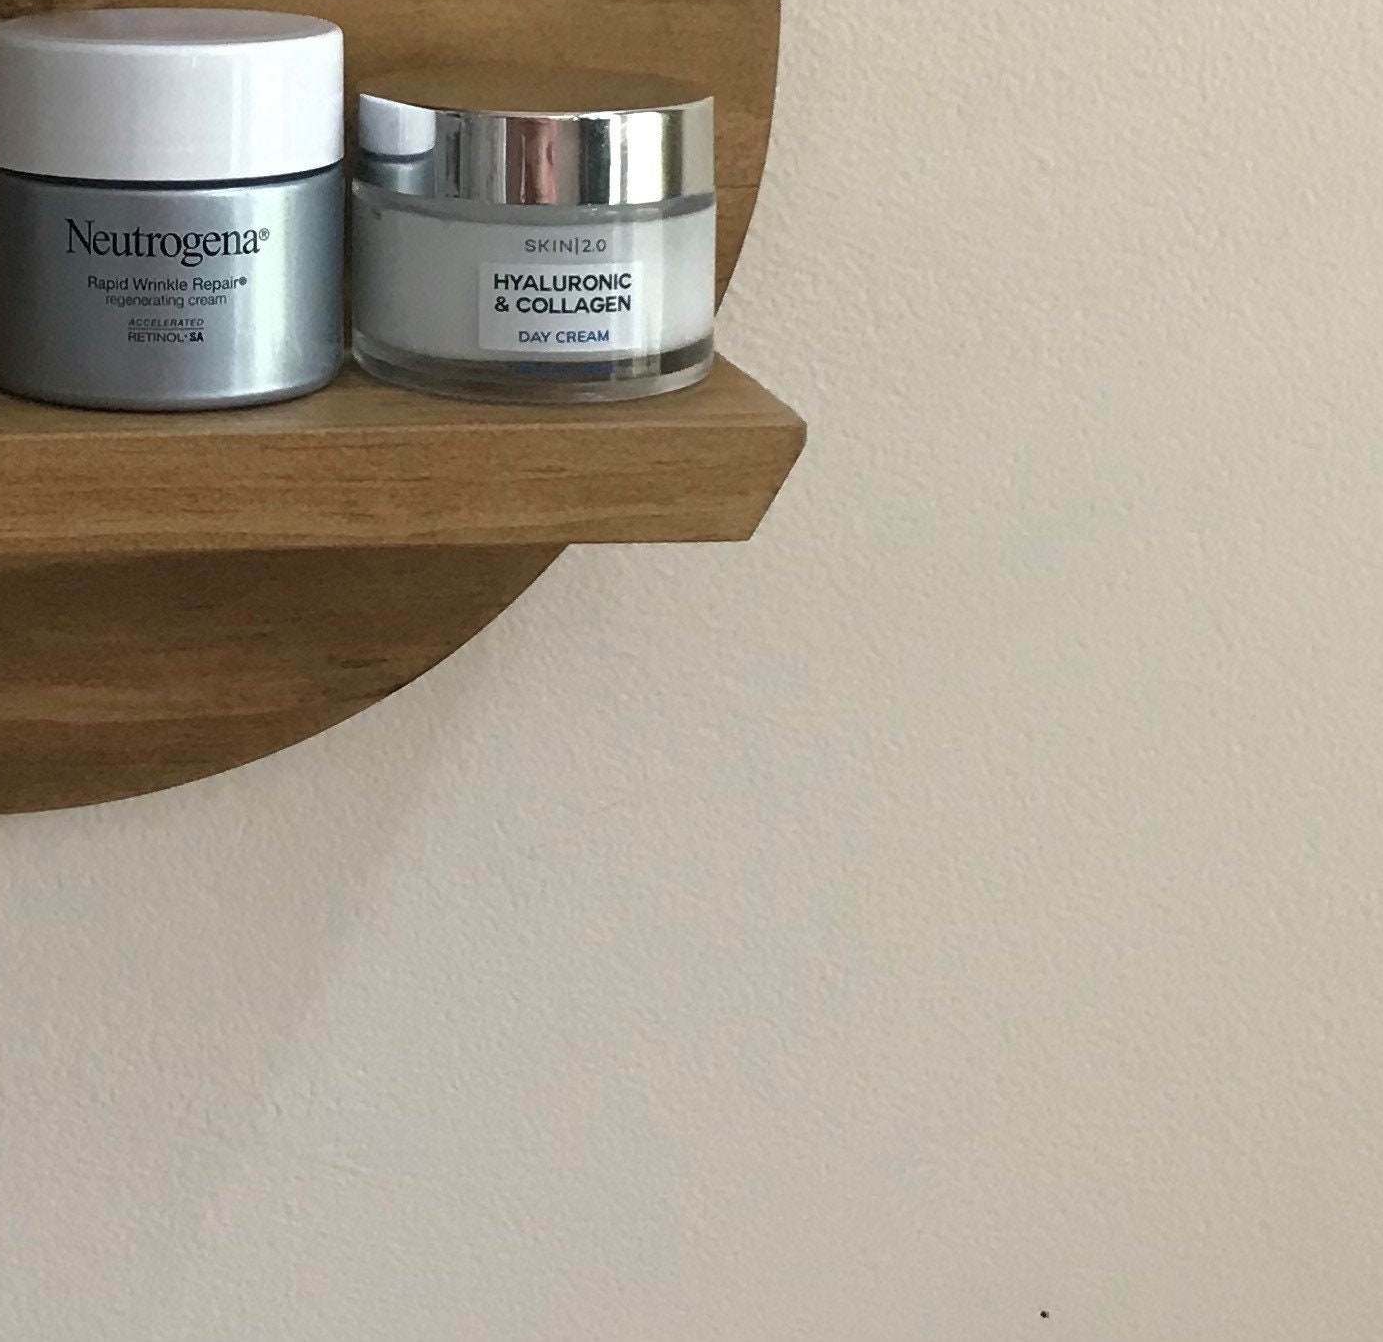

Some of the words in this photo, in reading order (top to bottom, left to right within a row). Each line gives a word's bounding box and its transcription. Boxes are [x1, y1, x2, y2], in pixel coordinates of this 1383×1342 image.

[87, 275, 129, 292] Rapid
[133, 277, 188, 291] Wrinkle
[493, 272, 632, 292] HYALURONIC
[105, 294, 185, 308] regenerating
[188, 293, 227, 306] cream
[494, 296, 509, 313] &
[516, 295, 631, 314] COLLAGEN
[128, 318, 205, 327] ACCELERATED
[518, 330, 551, 343] DAY
[555, 330, 610, 343] CREAM
